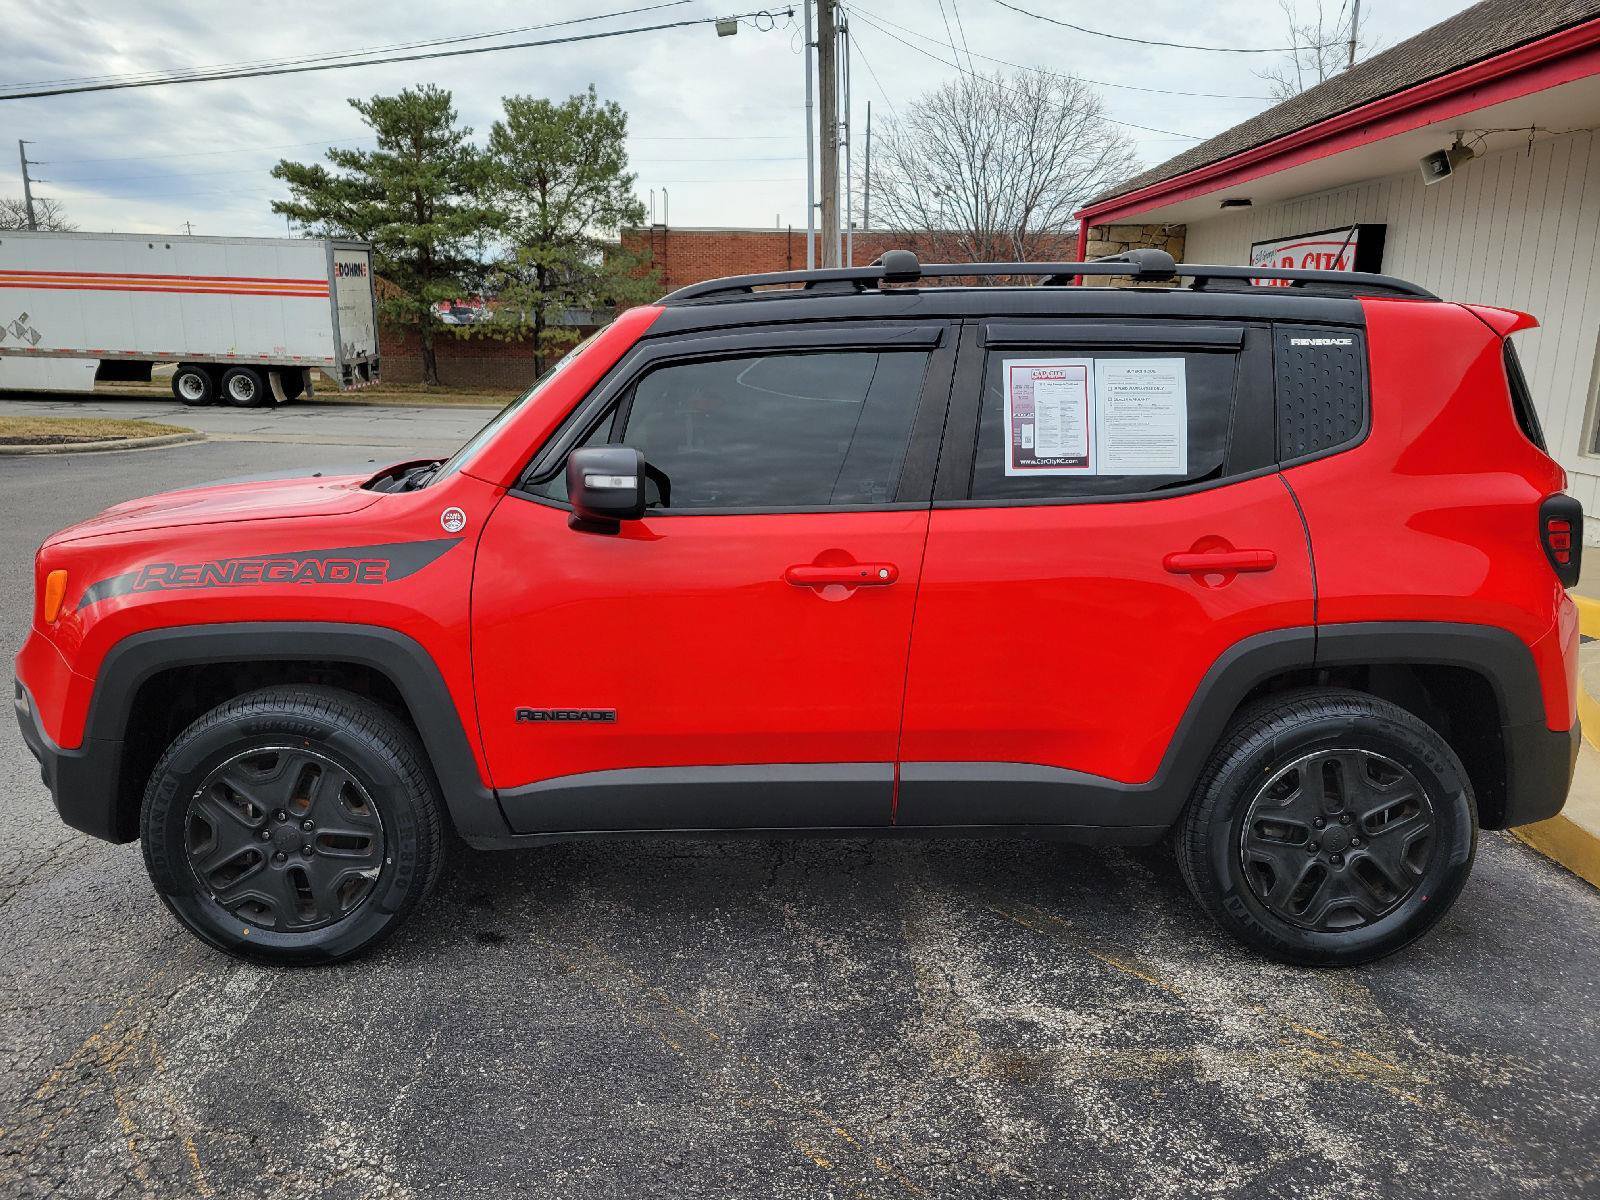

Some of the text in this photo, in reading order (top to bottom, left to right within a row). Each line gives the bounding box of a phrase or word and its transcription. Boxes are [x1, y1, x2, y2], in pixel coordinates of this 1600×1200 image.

[338, 262, 363, 278] DOHRN
[1290, 338, 1353, 346] RENEGADE
[133, 559, 390, 590] RENEGADE
[516, 708, 616, 722] RENEGADE
